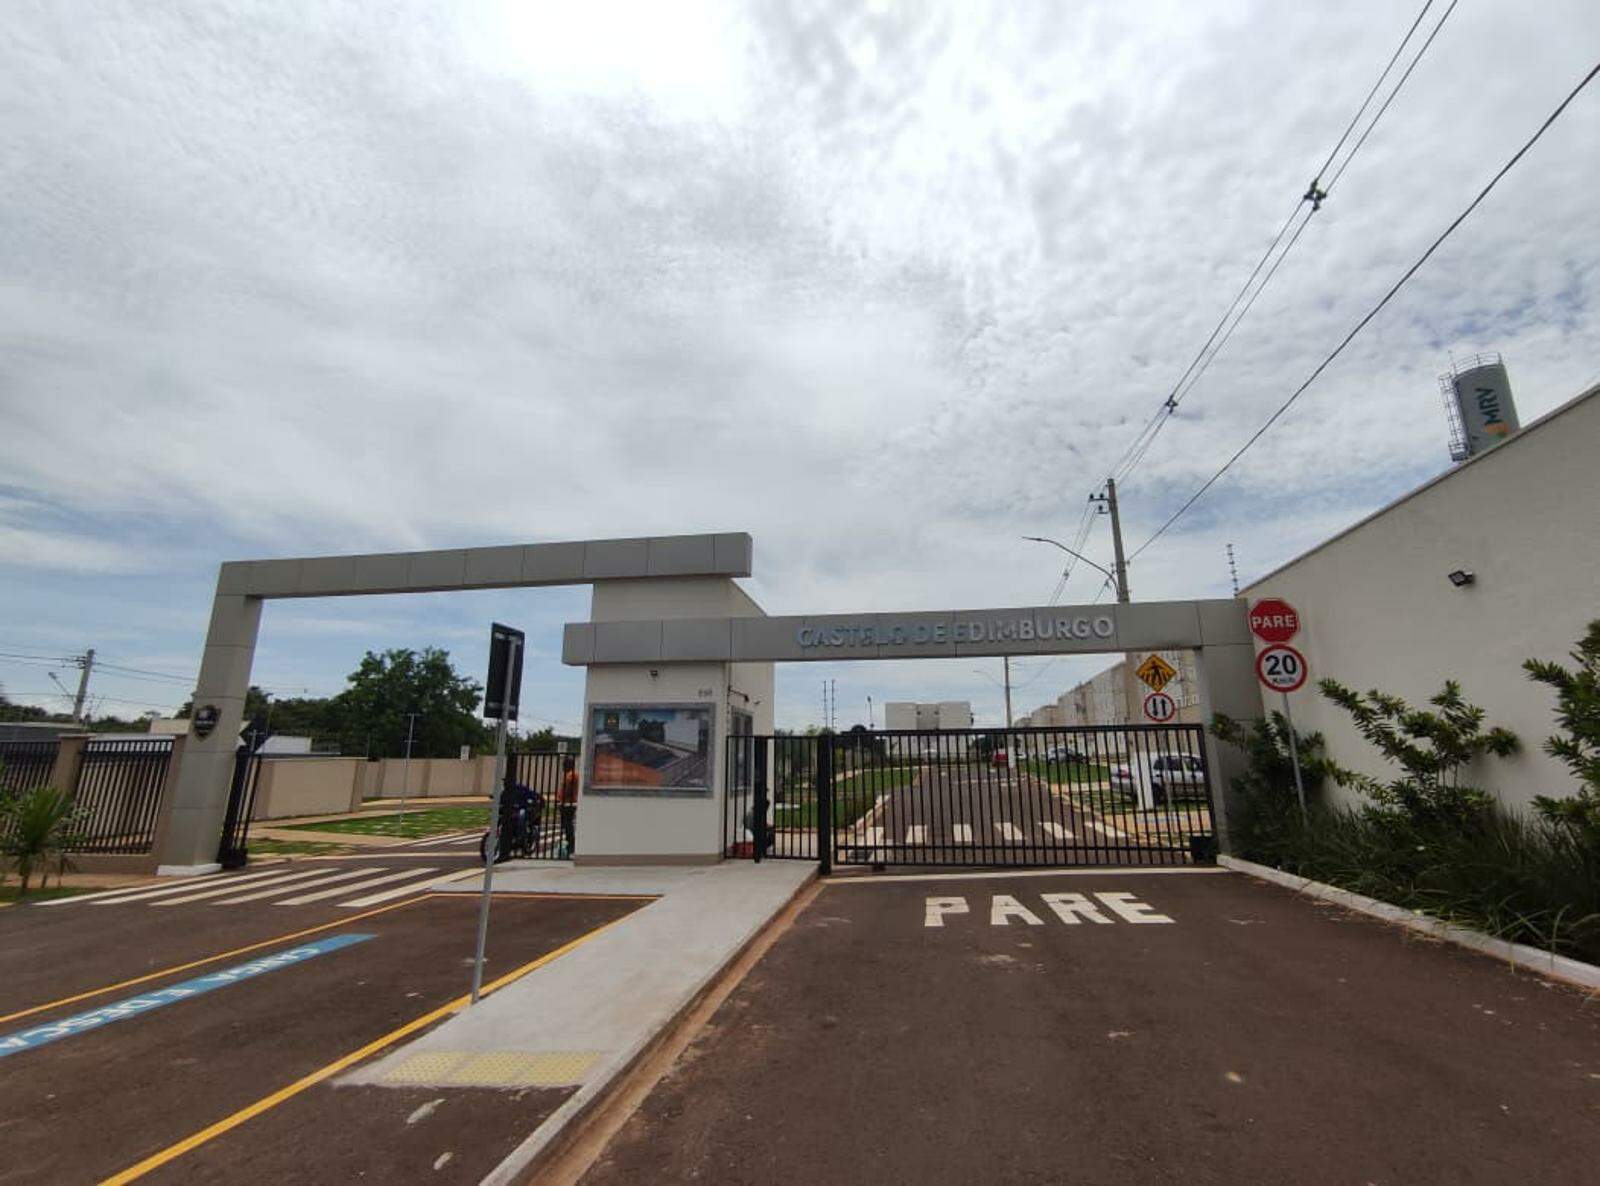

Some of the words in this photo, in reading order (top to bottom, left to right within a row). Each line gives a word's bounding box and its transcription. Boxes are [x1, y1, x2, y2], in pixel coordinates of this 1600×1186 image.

[799, 625, 905, 648] CASTELO
[911, 623, 946, 644] DE
[953, 616, 1115, 643] EDIMBURGO
[1251, 615, 1296, 628] PARE
[1265, 655, 1297, 675] 20
[925, 892, 1176, 927] PARE
